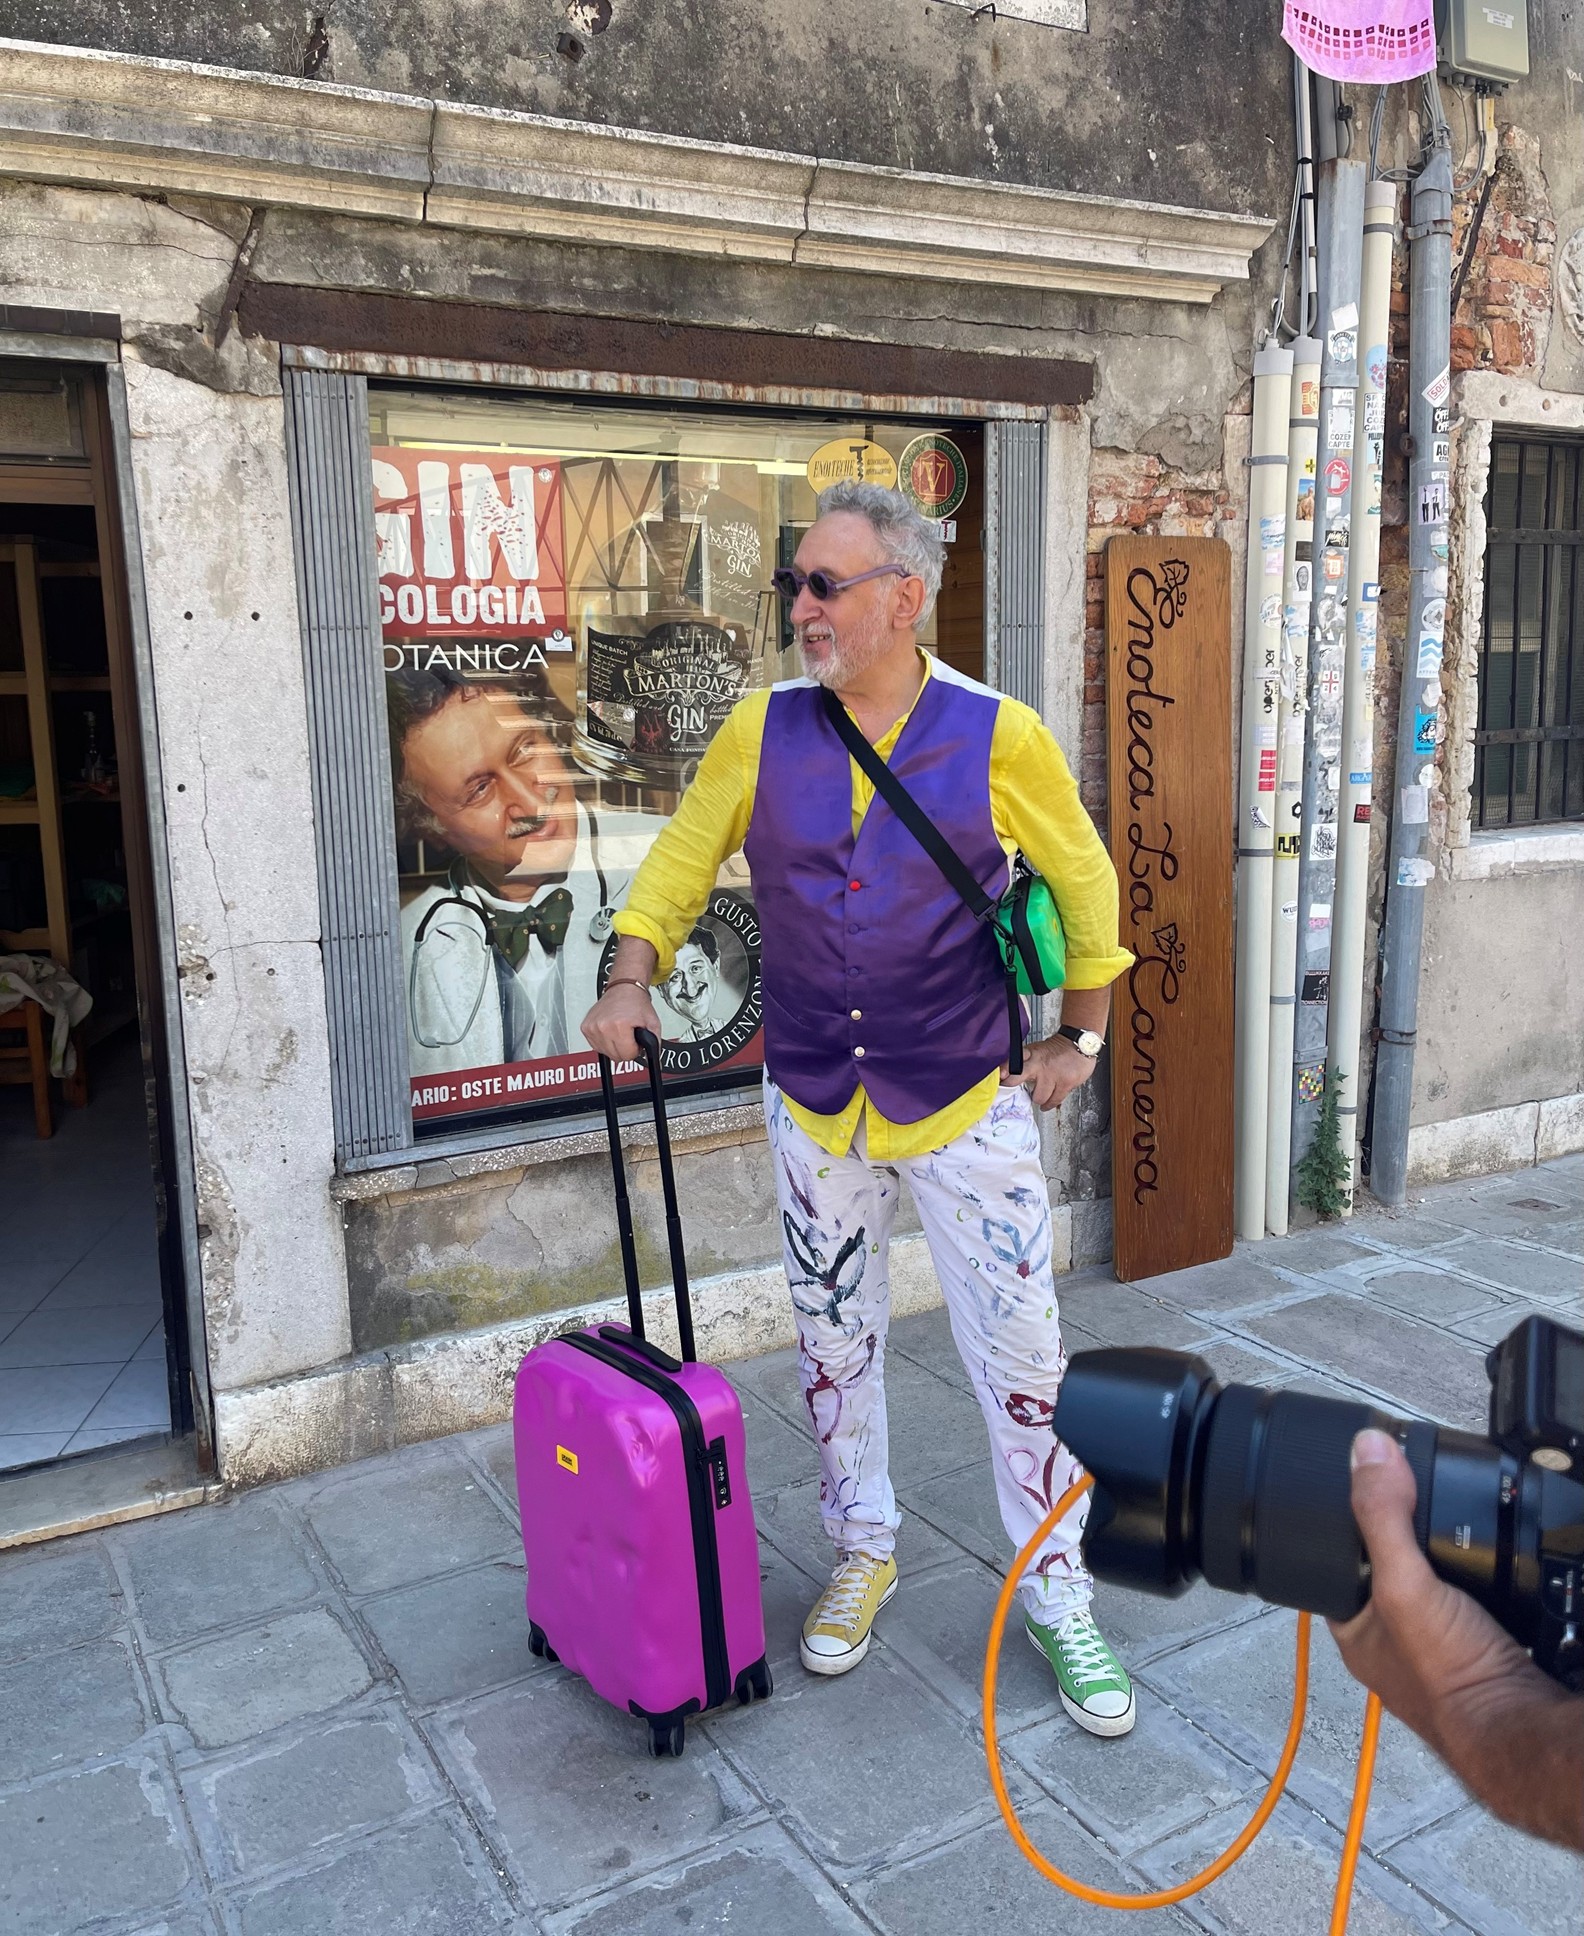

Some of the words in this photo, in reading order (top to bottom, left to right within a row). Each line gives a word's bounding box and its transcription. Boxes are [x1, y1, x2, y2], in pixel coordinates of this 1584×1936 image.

[372, 459, 540, 580] GIN
[727, 555, 752, 578] GIN
[662, 655, 716, 670] ORIGINAL
[639, 673, 737, 697] MARTON'S
[1126, 567, 1176, 811] Enoteca
[667, 704, 708, 741] GIN
[1128, 822, 1178, 926] La
[714, 897, 762, 947] GUSTO
[461, 1077, 502, 1099] OSTE
[507, 1068, 564, 1092] MAURO
[1129, 942, 1178, 1205] Caneva
[1455, 1525, 1463, 1547] GF
